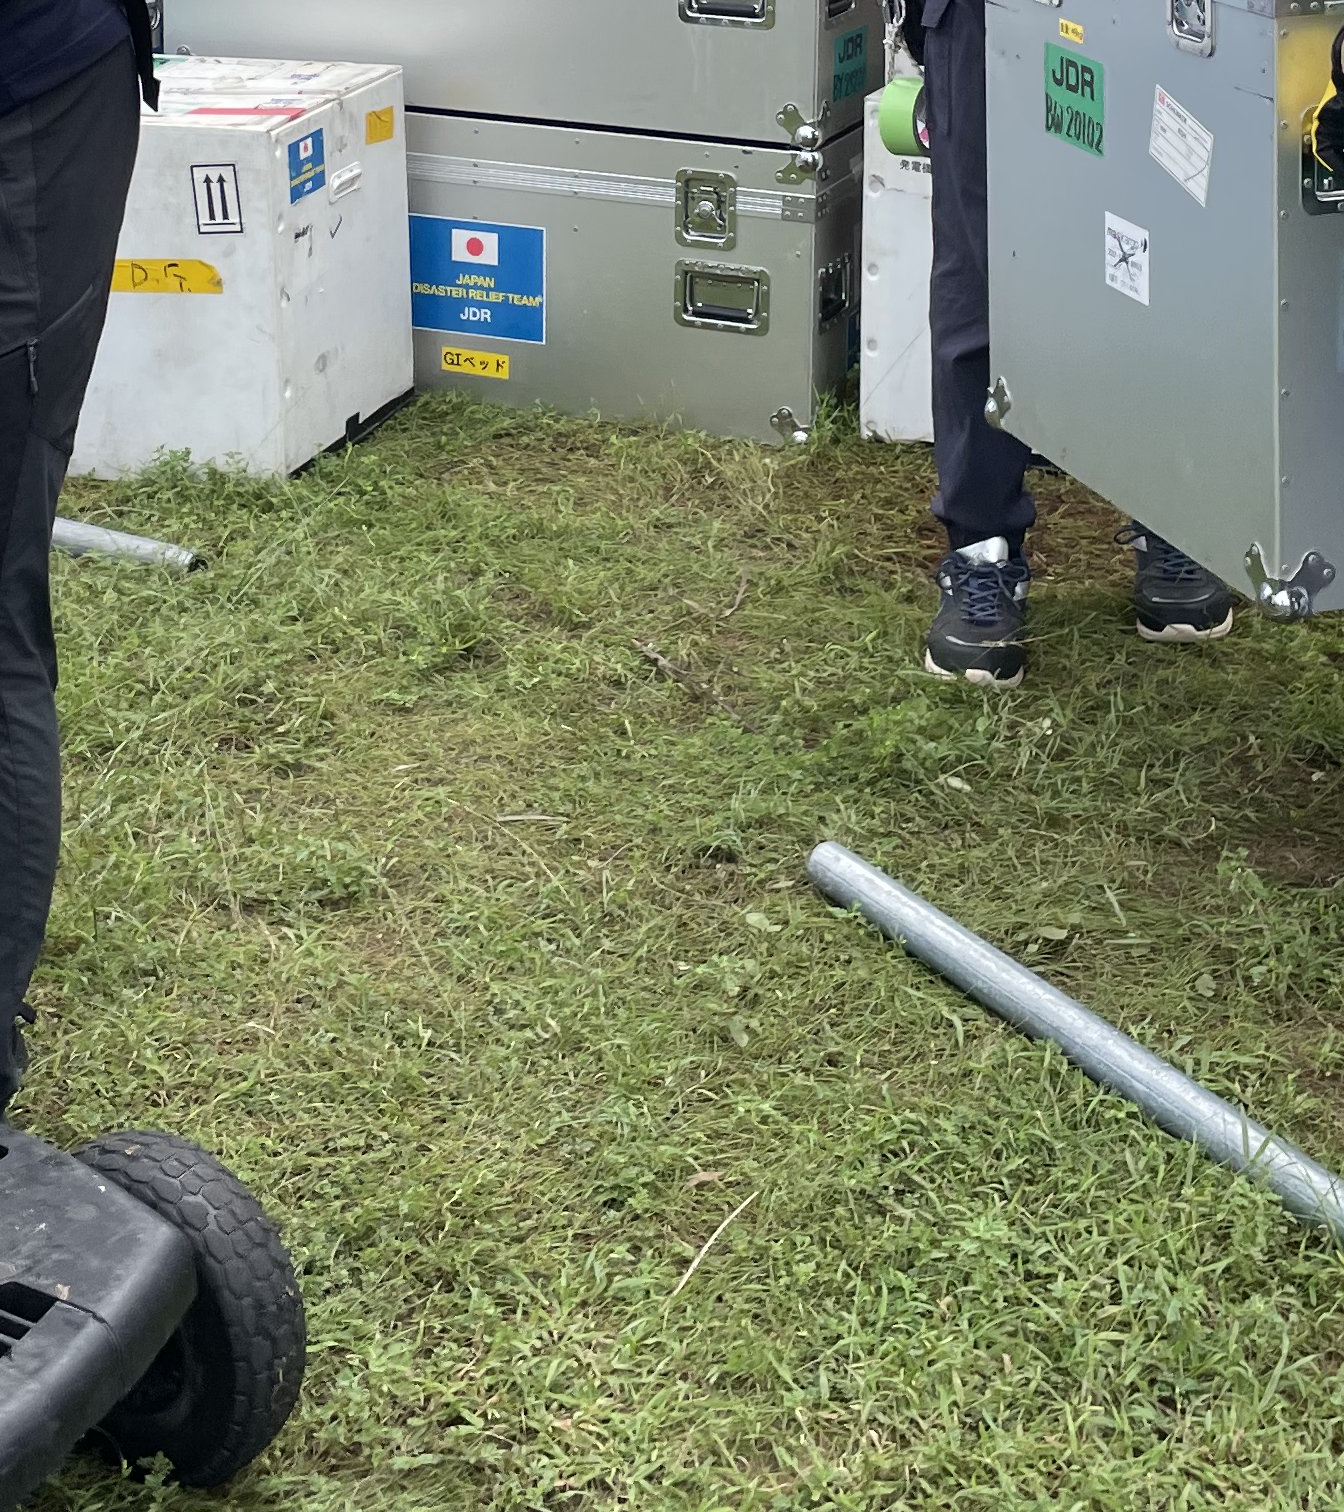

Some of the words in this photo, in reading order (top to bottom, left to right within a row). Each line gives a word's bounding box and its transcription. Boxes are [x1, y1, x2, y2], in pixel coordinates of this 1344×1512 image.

[838, 33, 863, 64] JDR
[1052, 56, 1095, 102] JDR
[456, 274, 494, 288] JAPAN
[412, 283, 466, 299] DISASTER
[469, 289, 506, 302] RELIEF
[507, 293, 541, 307] TEAM
[460, 307, 492, 322] JDR
[443, 352, 506, 373] GIベッド
